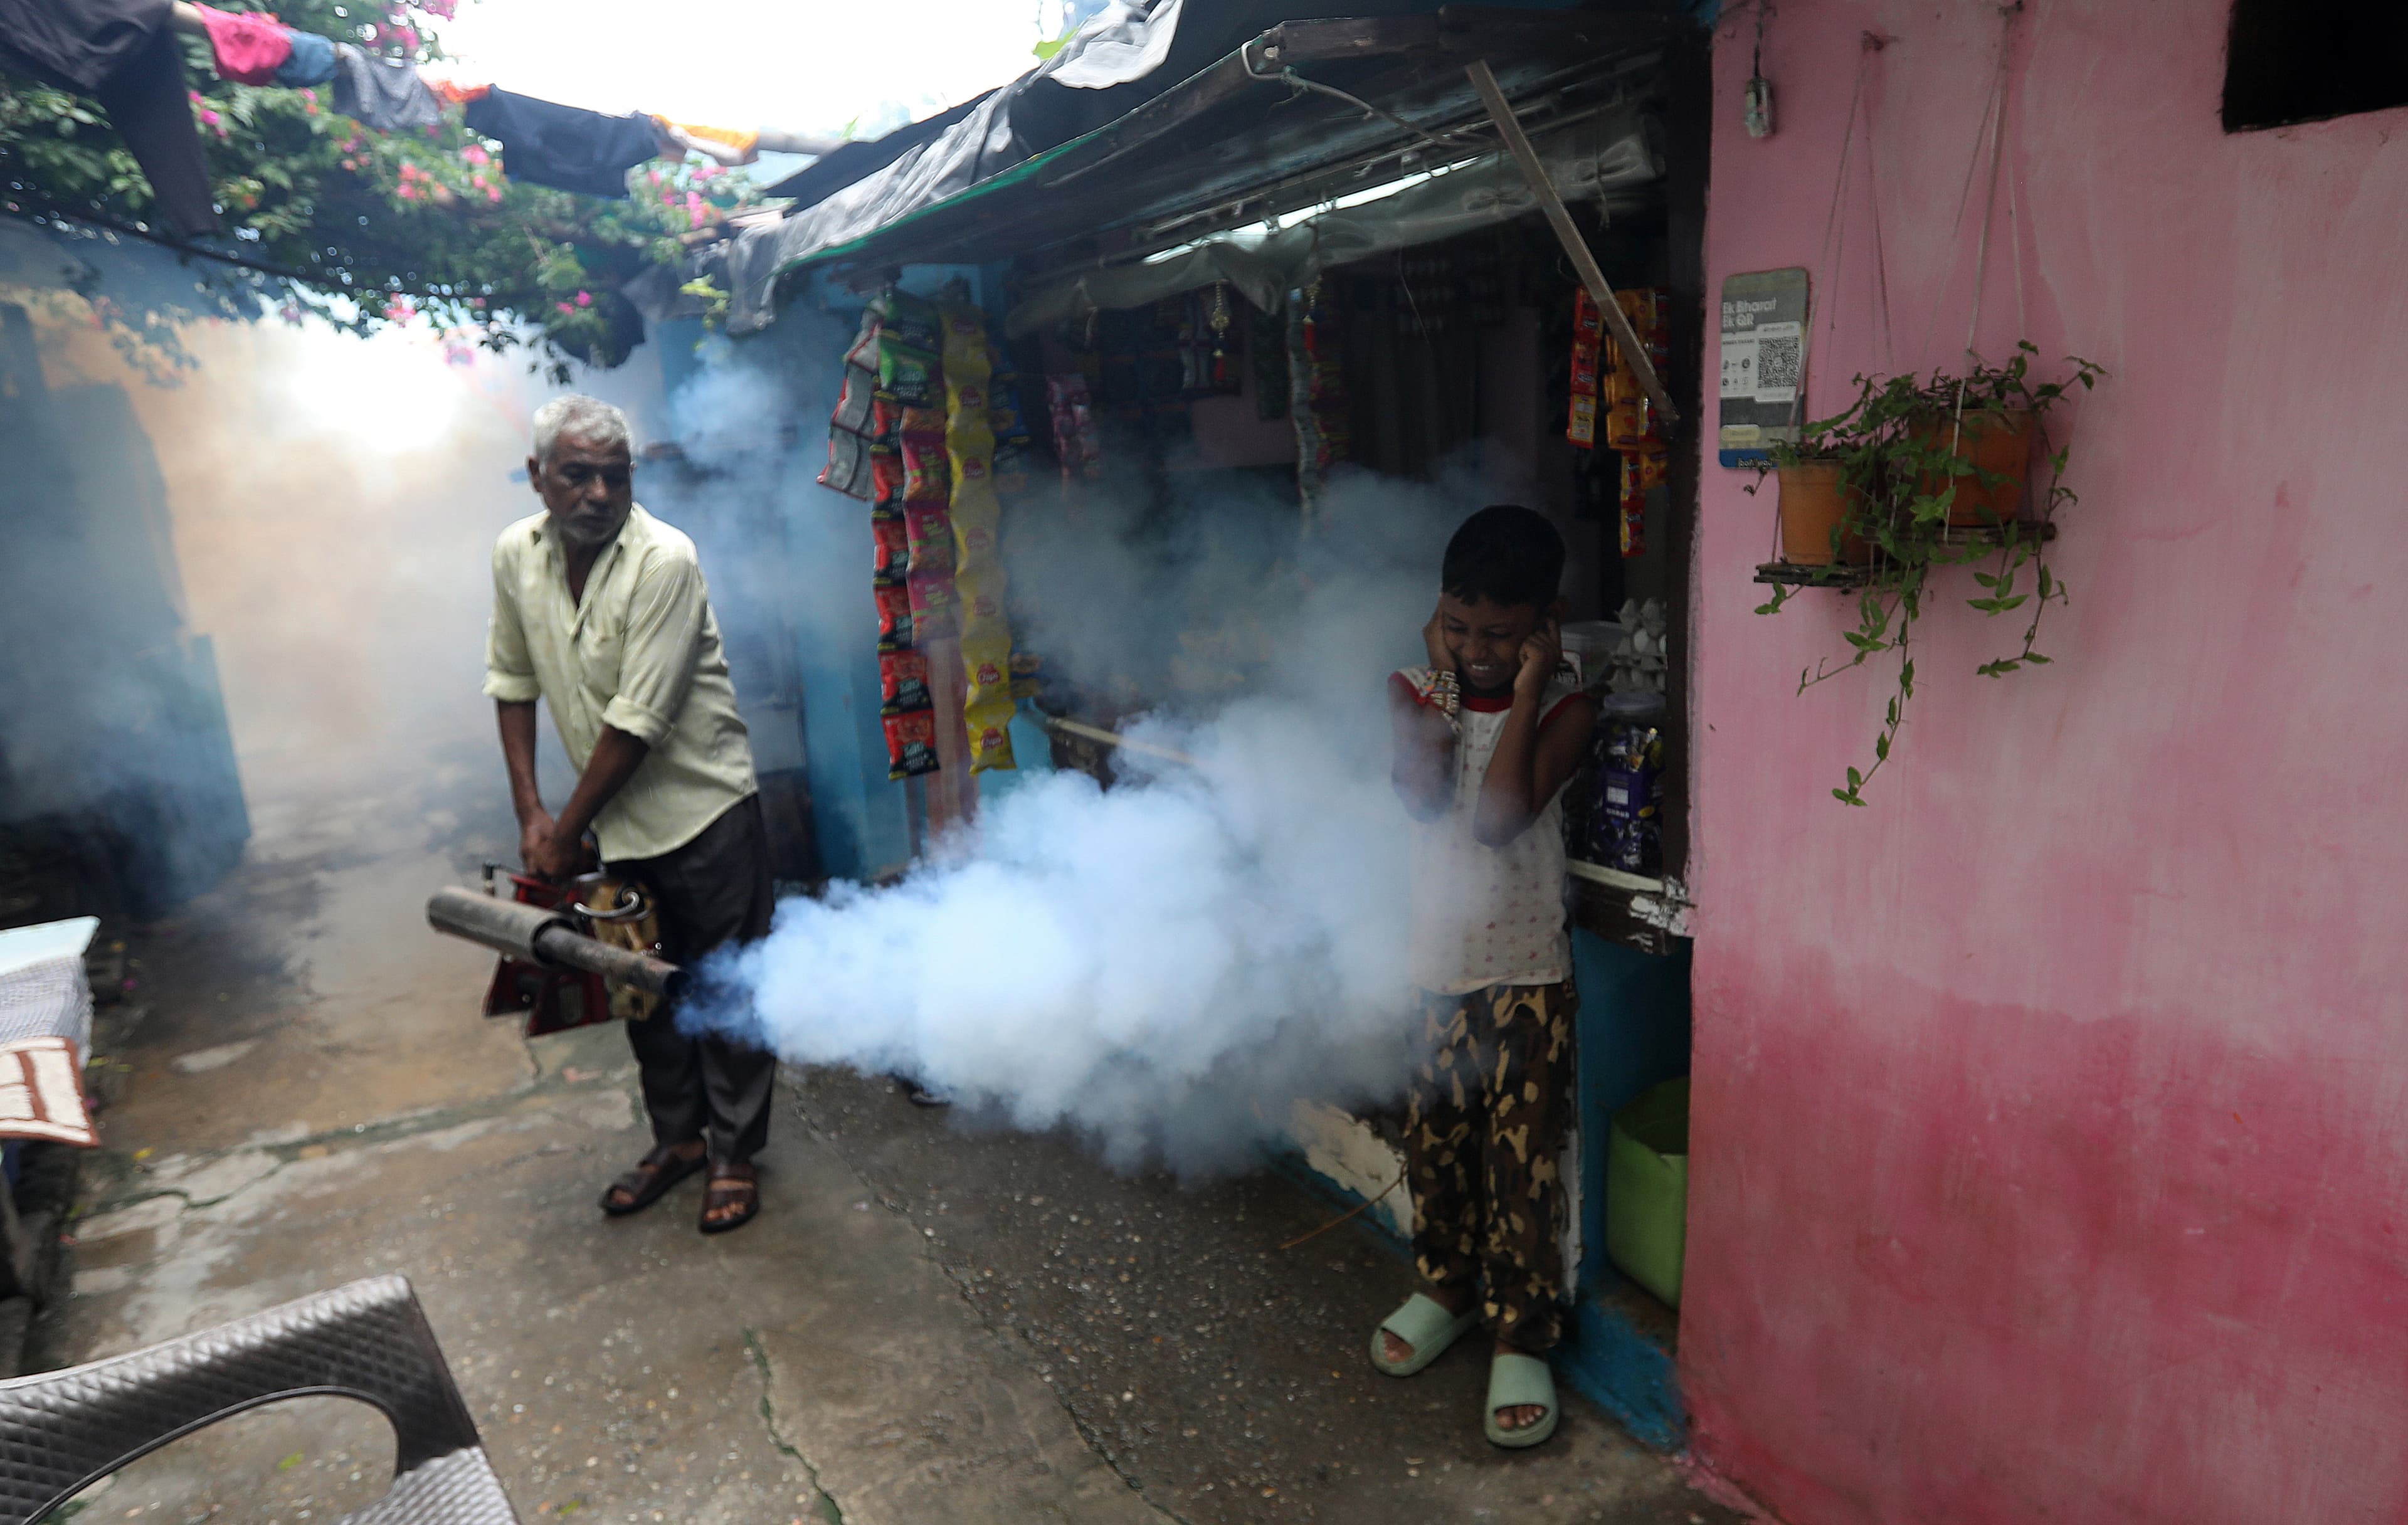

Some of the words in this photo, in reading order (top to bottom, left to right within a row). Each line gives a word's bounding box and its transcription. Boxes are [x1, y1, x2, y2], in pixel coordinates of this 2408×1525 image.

[1723, 302, 1736, 314] Ek
[1736, 297, 1777, 312] Bharat
[1723, 315, 1735, 327] Ek
[1736, 313, 1755, 325] QR
